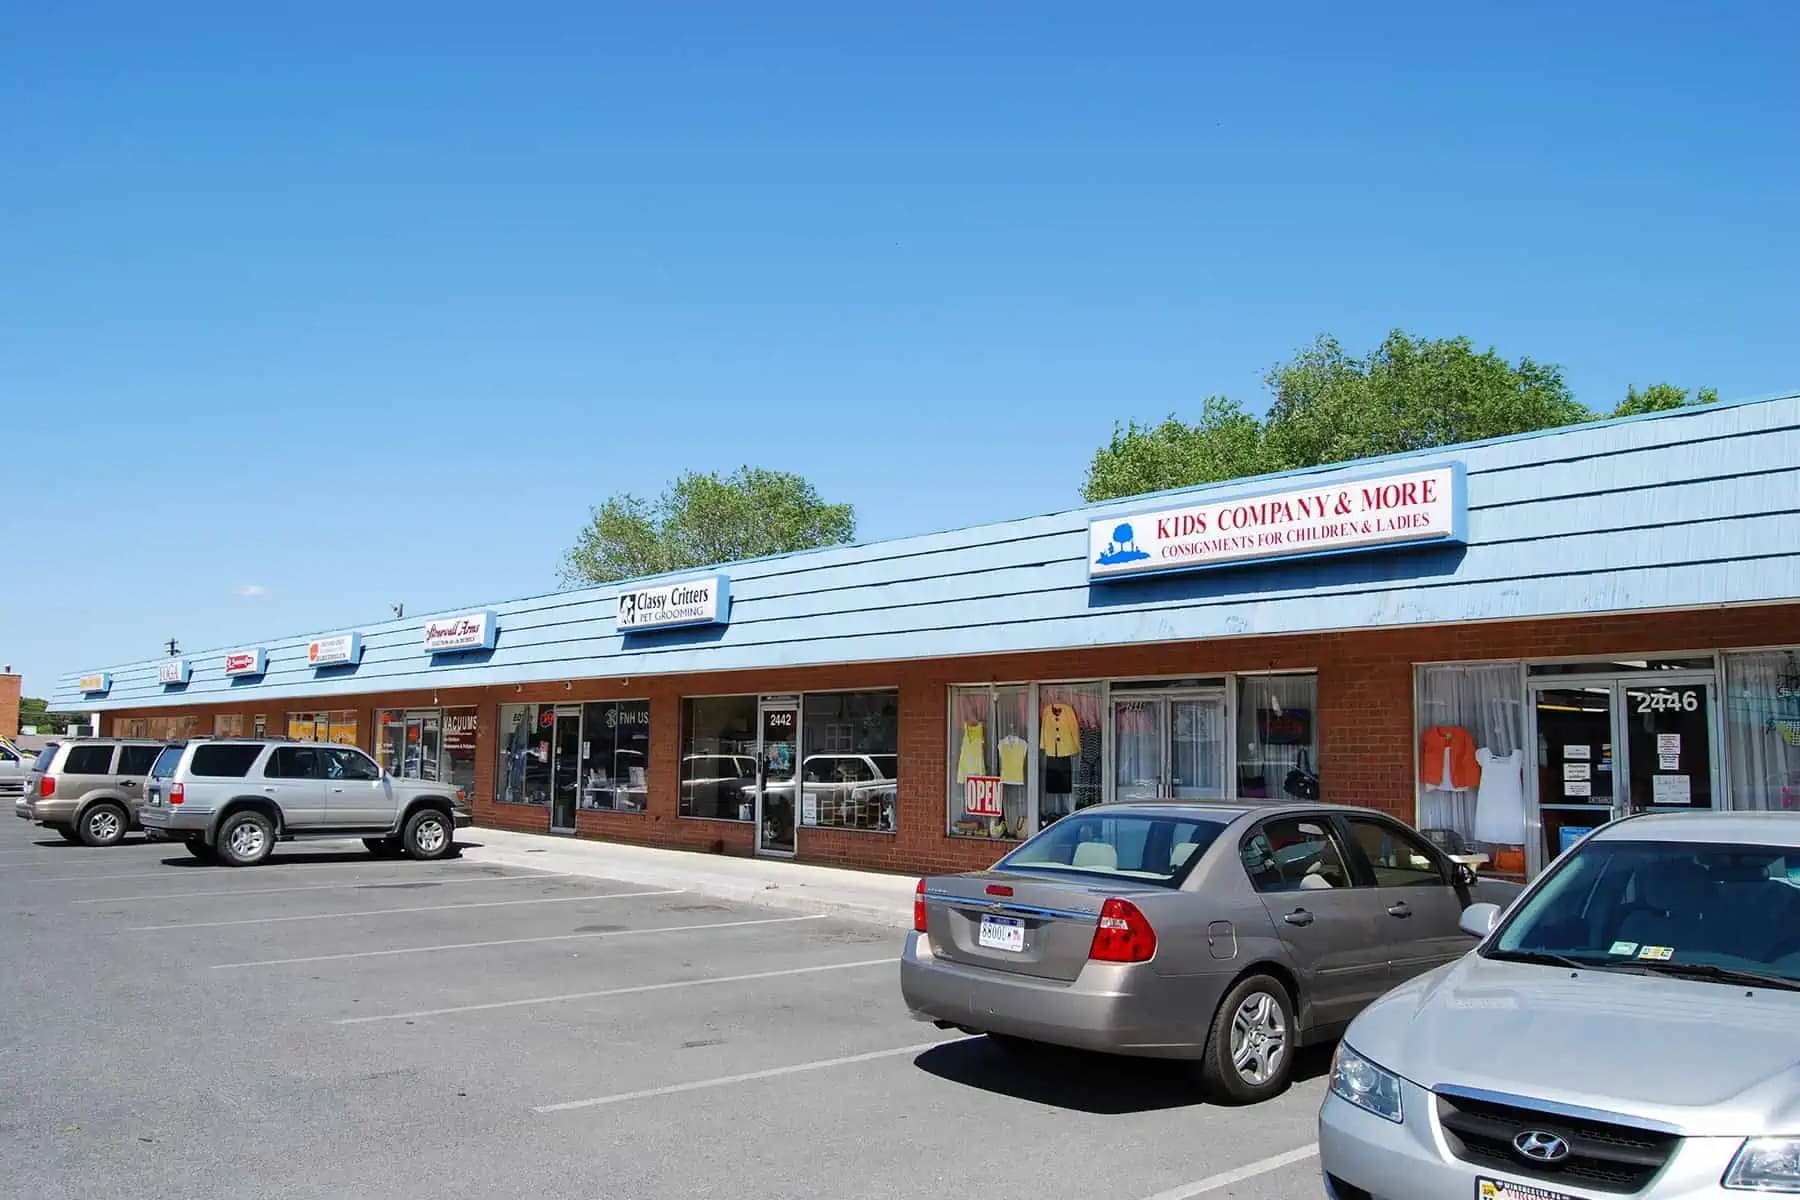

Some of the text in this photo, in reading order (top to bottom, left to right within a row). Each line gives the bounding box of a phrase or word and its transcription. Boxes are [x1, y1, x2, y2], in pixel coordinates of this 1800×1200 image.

[1157, 479, 1437, 539] KIDS COMPANY & MORE
[1161, 512, 1430, 559] CONSIGNMENTS FOR CHILDREN & LADIES
[637, 586, 709, 611] Classy Critters
[640, 606, 704, 622] PET GROOMING
[1637, 691, 1698, 712] 2446
[443, 715, 478, 730] VACUUMS
[619, 711, 635, 725] FNH
[770, 714, 792, 726] 2442
[966, 779, 1002, 812] OPEN
